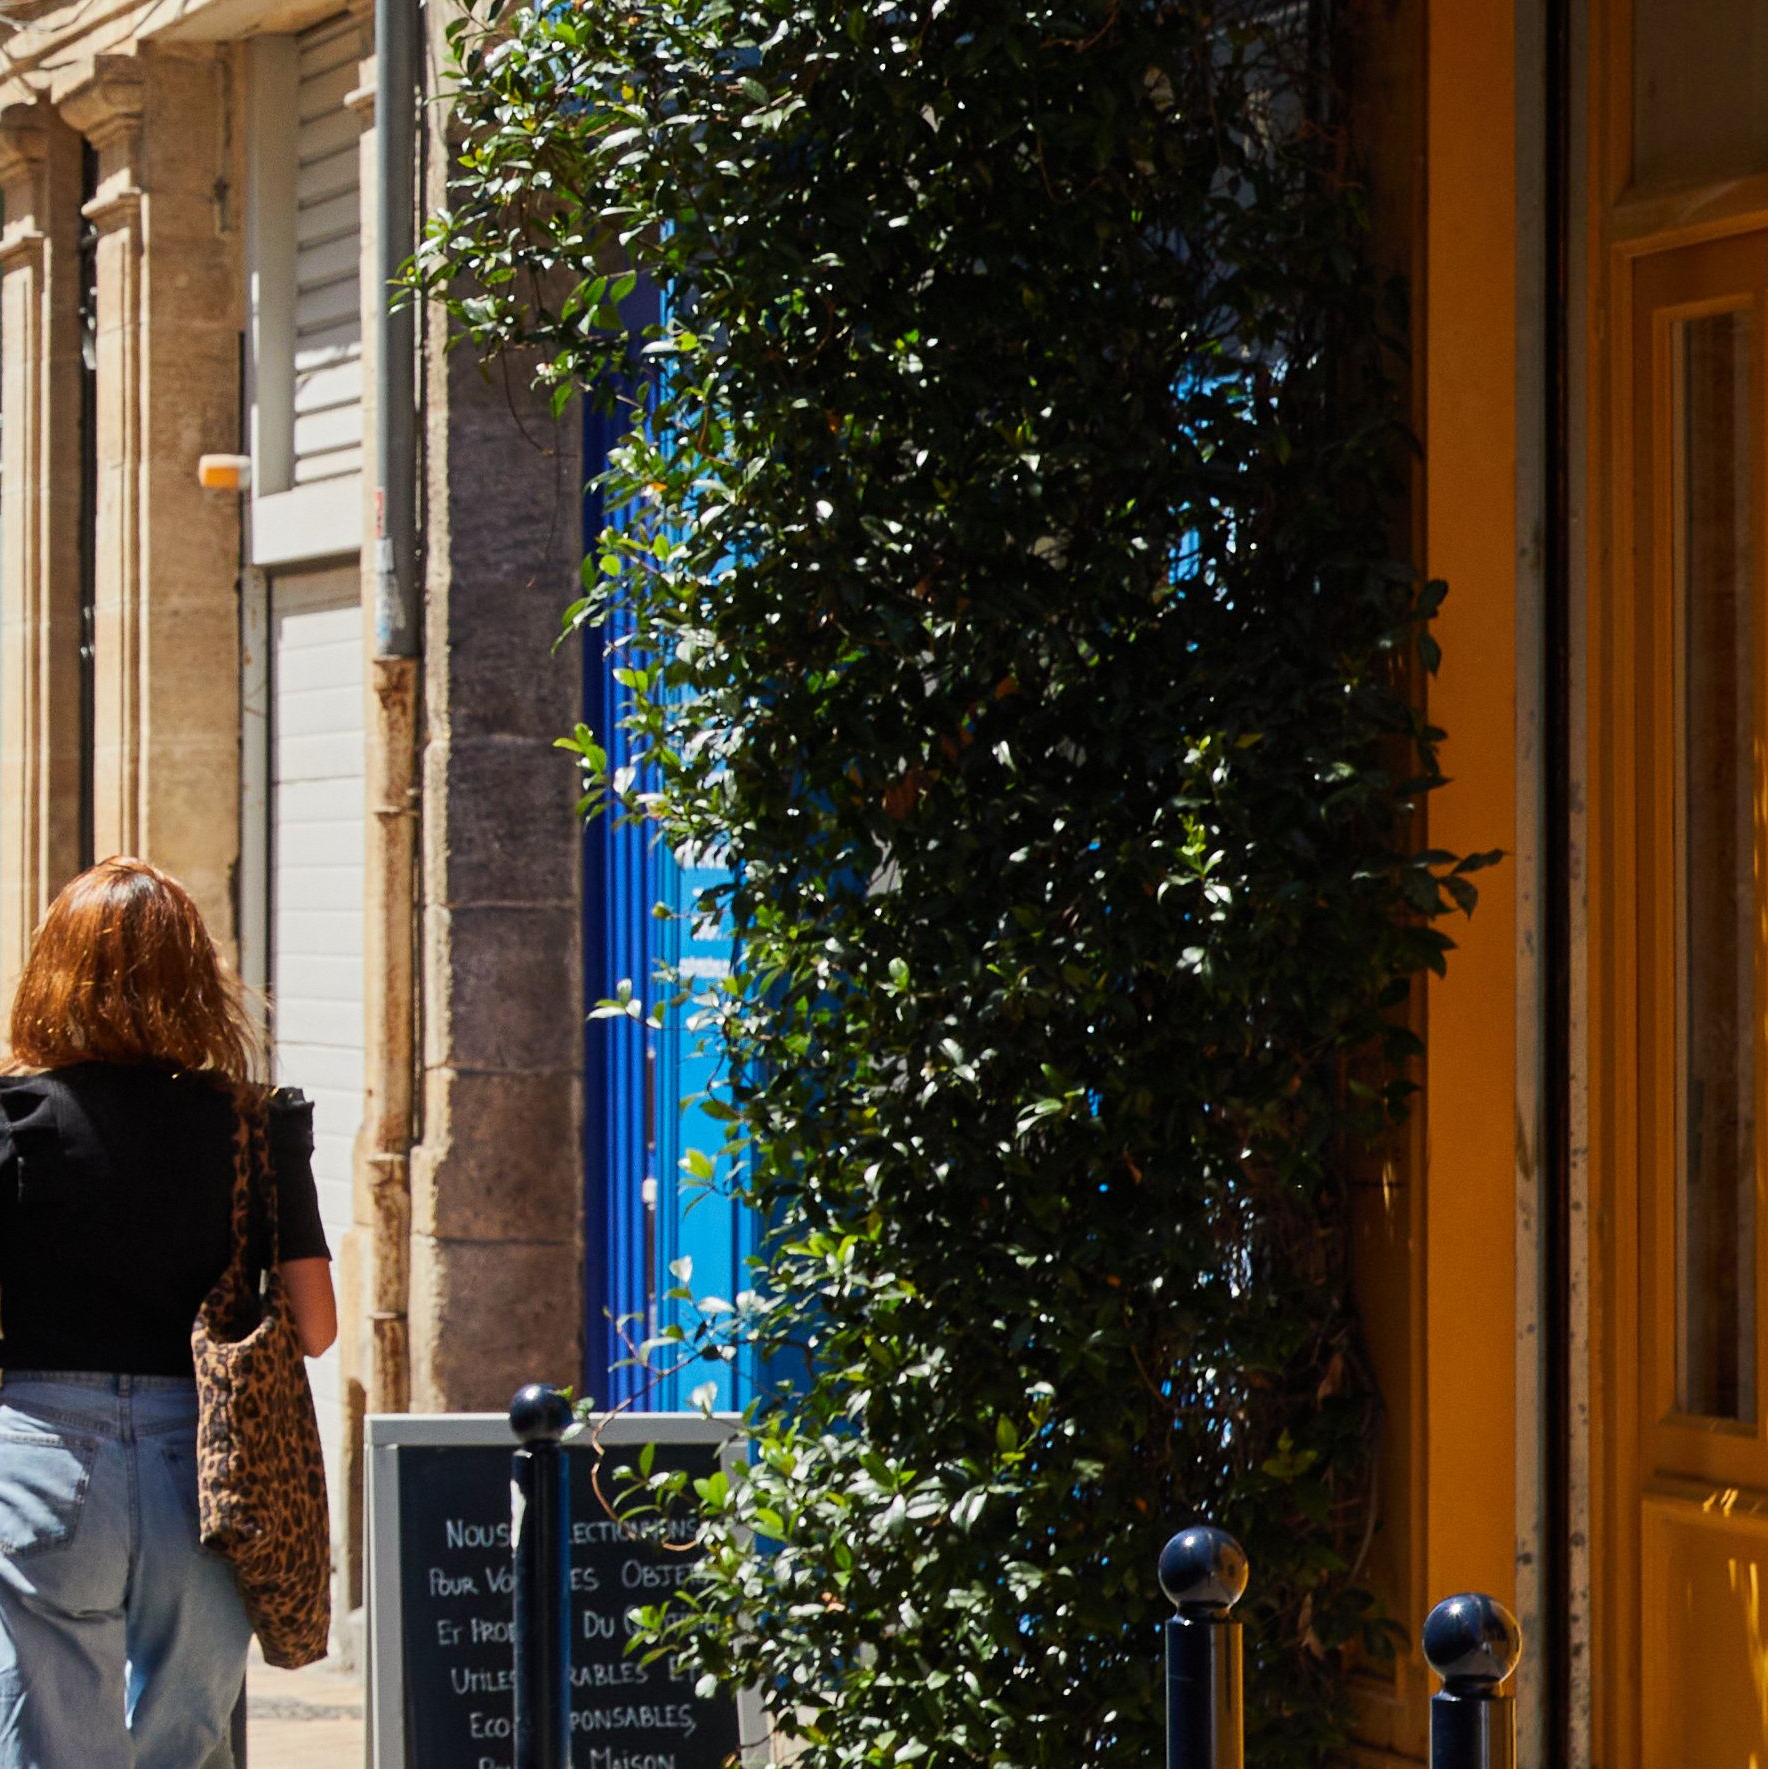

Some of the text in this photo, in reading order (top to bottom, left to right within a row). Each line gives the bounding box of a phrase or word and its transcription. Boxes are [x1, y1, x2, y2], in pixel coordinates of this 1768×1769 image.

[429, 1567, 478, 1597] POUR
[570, 1568, 601, 1591] ES
[584, 1610, 614, 1639] DU
[569, 1662, 649, 1687] RABLES
